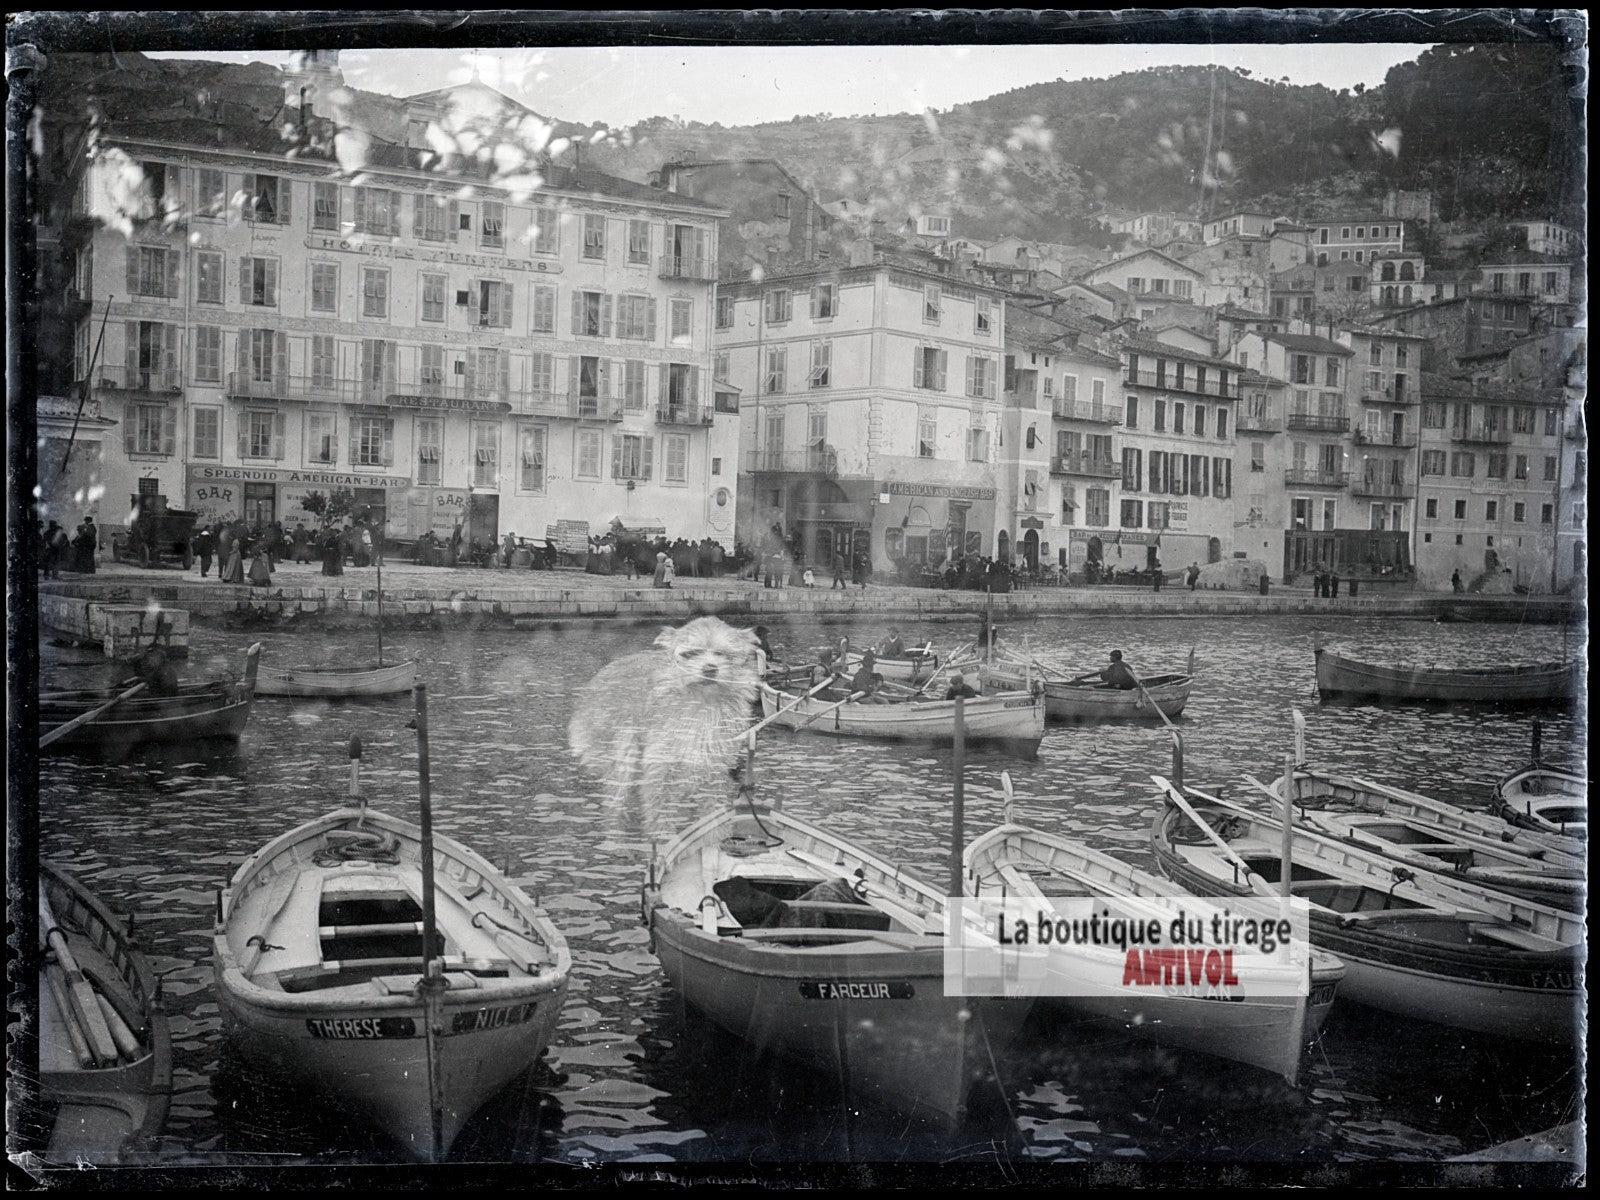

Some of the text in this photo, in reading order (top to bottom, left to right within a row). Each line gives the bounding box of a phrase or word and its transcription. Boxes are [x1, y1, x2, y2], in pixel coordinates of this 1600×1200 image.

[399, 396, 500, 410] RESTAURANT
[204, 468, 398, 487] SPLENDID AMERICAN-BAR
[196, 486, 232, 502] BAR
[892, 483, 933, 497] AMERICAN
[436, 494, 464, 508] BAR
[817, 983, 891, 999] FARCEUR
[312, 1019, 382, 1038] THERESE
